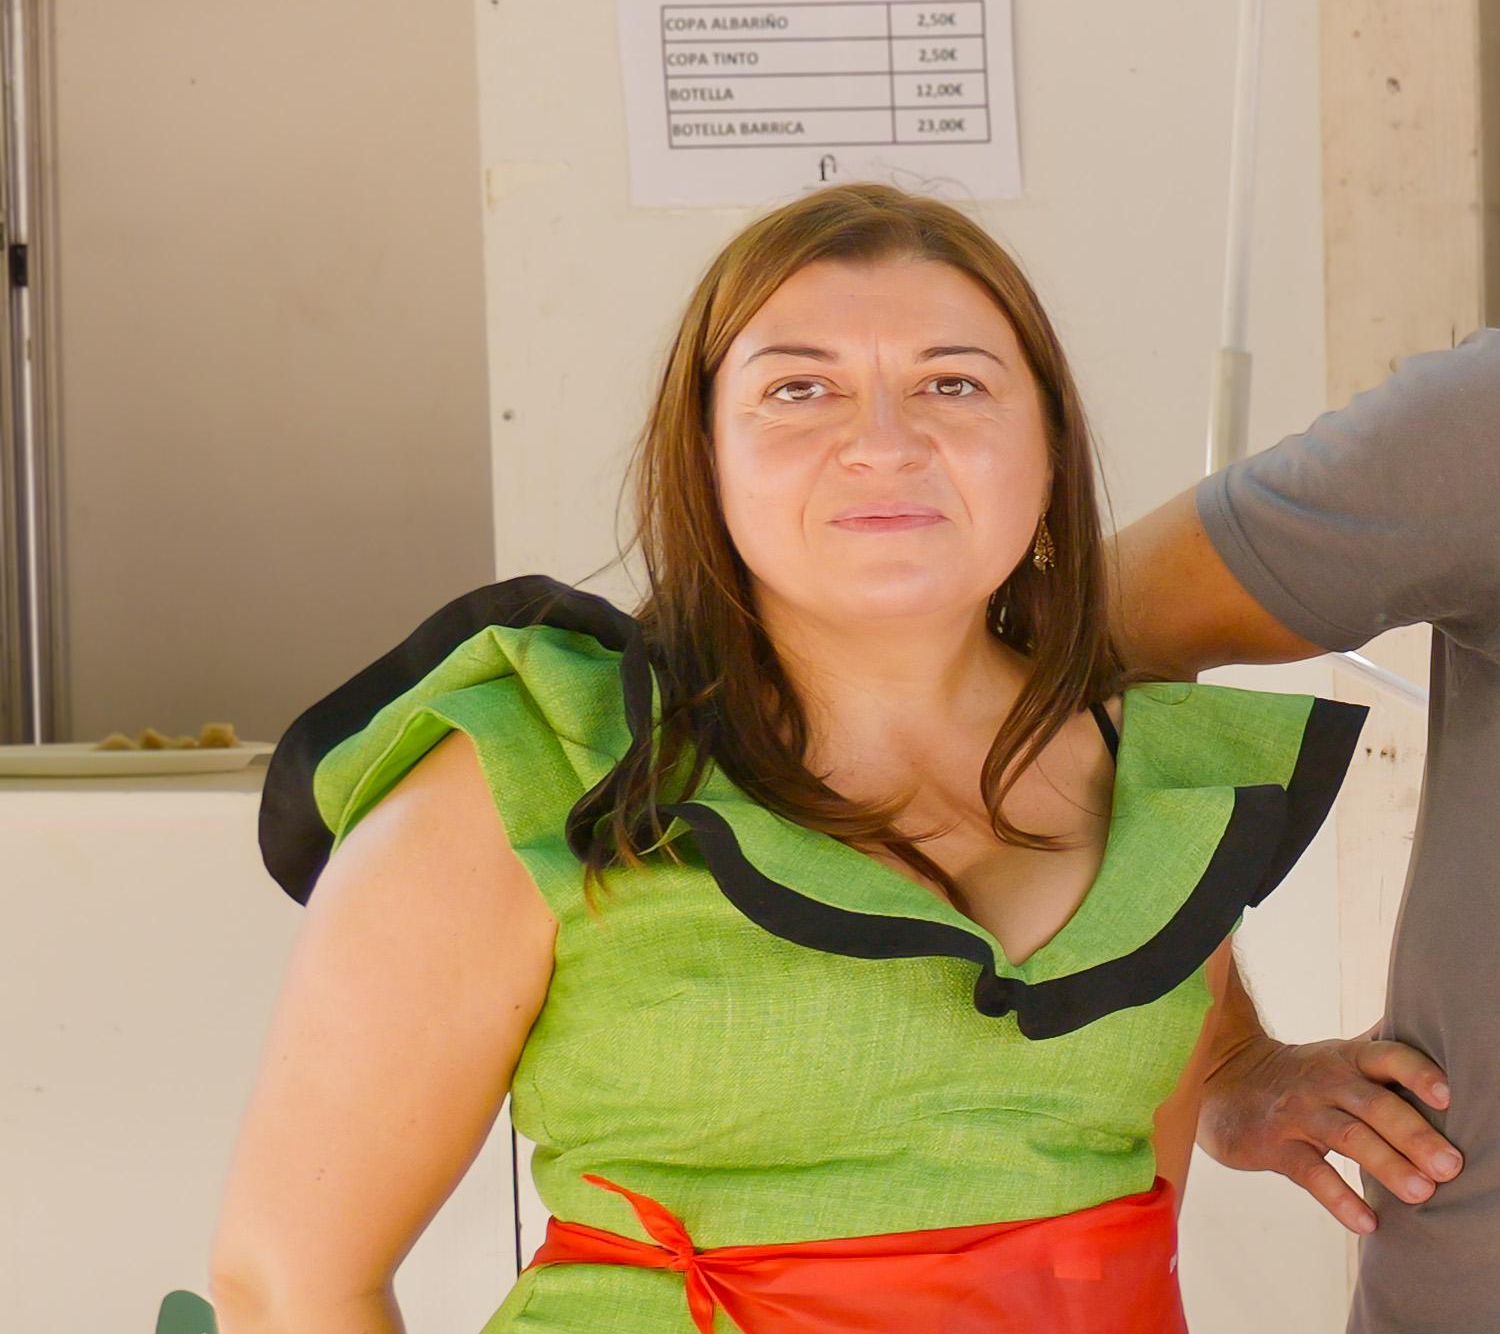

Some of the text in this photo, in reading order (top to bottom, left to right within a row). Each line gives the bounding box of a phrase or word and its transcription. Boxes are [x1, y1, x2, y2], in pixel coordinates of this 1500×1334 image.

[664, 12, 956, 32] COPA ALBARIÑO 2,50€
[666, 48, 957, 67] COPA TINTO 2,50€
[669, 83, 963, 103] BOTELLA 12,00€
[671, 118, 965, 137] BOTELLA BARRICA 23,00€
